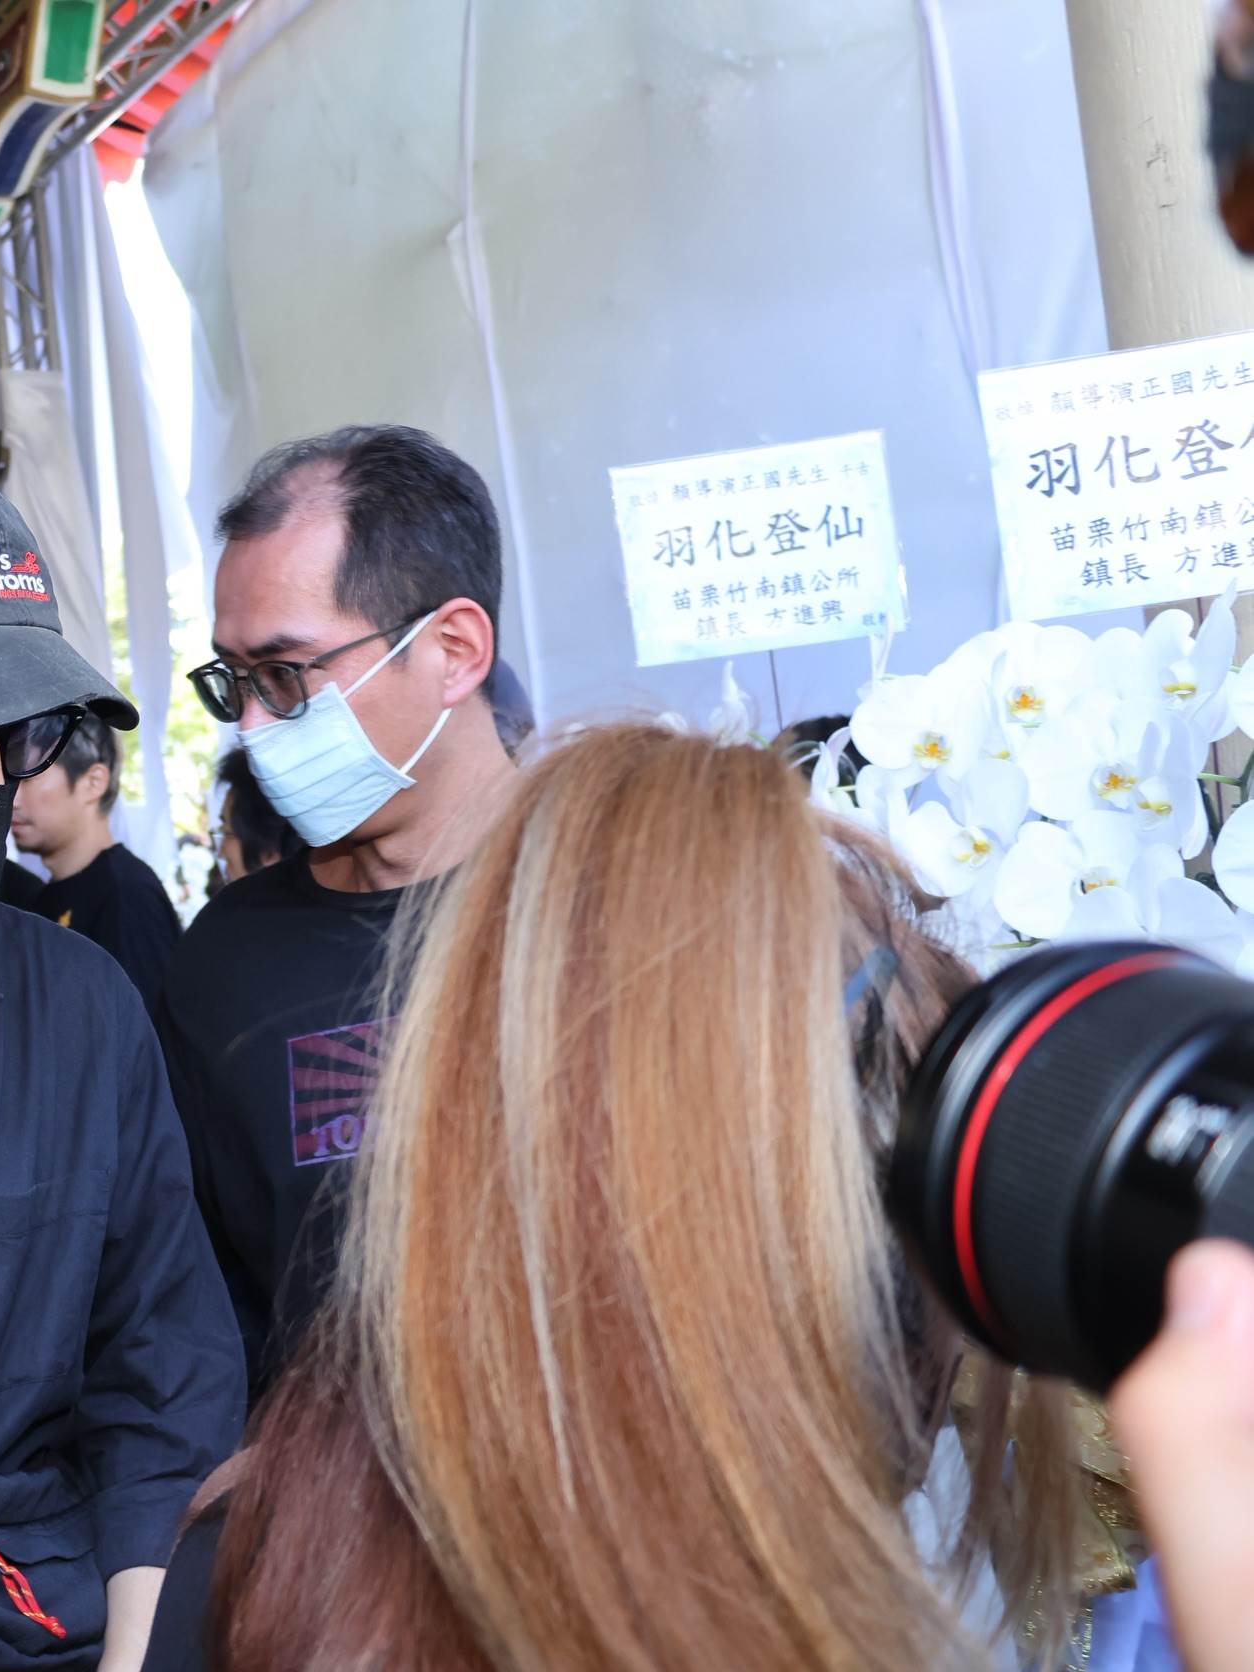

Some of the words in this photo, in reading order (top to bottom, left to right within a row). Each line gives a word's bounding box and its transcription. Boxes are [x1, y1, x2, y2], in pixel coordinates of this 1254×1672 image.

[1026, 419, 1254, 498] 羽化登
[653, 504, 864, 568] 羽化登仙
[672, 565, 860, 611] 苗栗竹南鎮公所
[1080, 553, 1150, 588] 鎮長
[1174, 537, 1254, 574] 方進
[764, 600, 845, 628] 方進興
